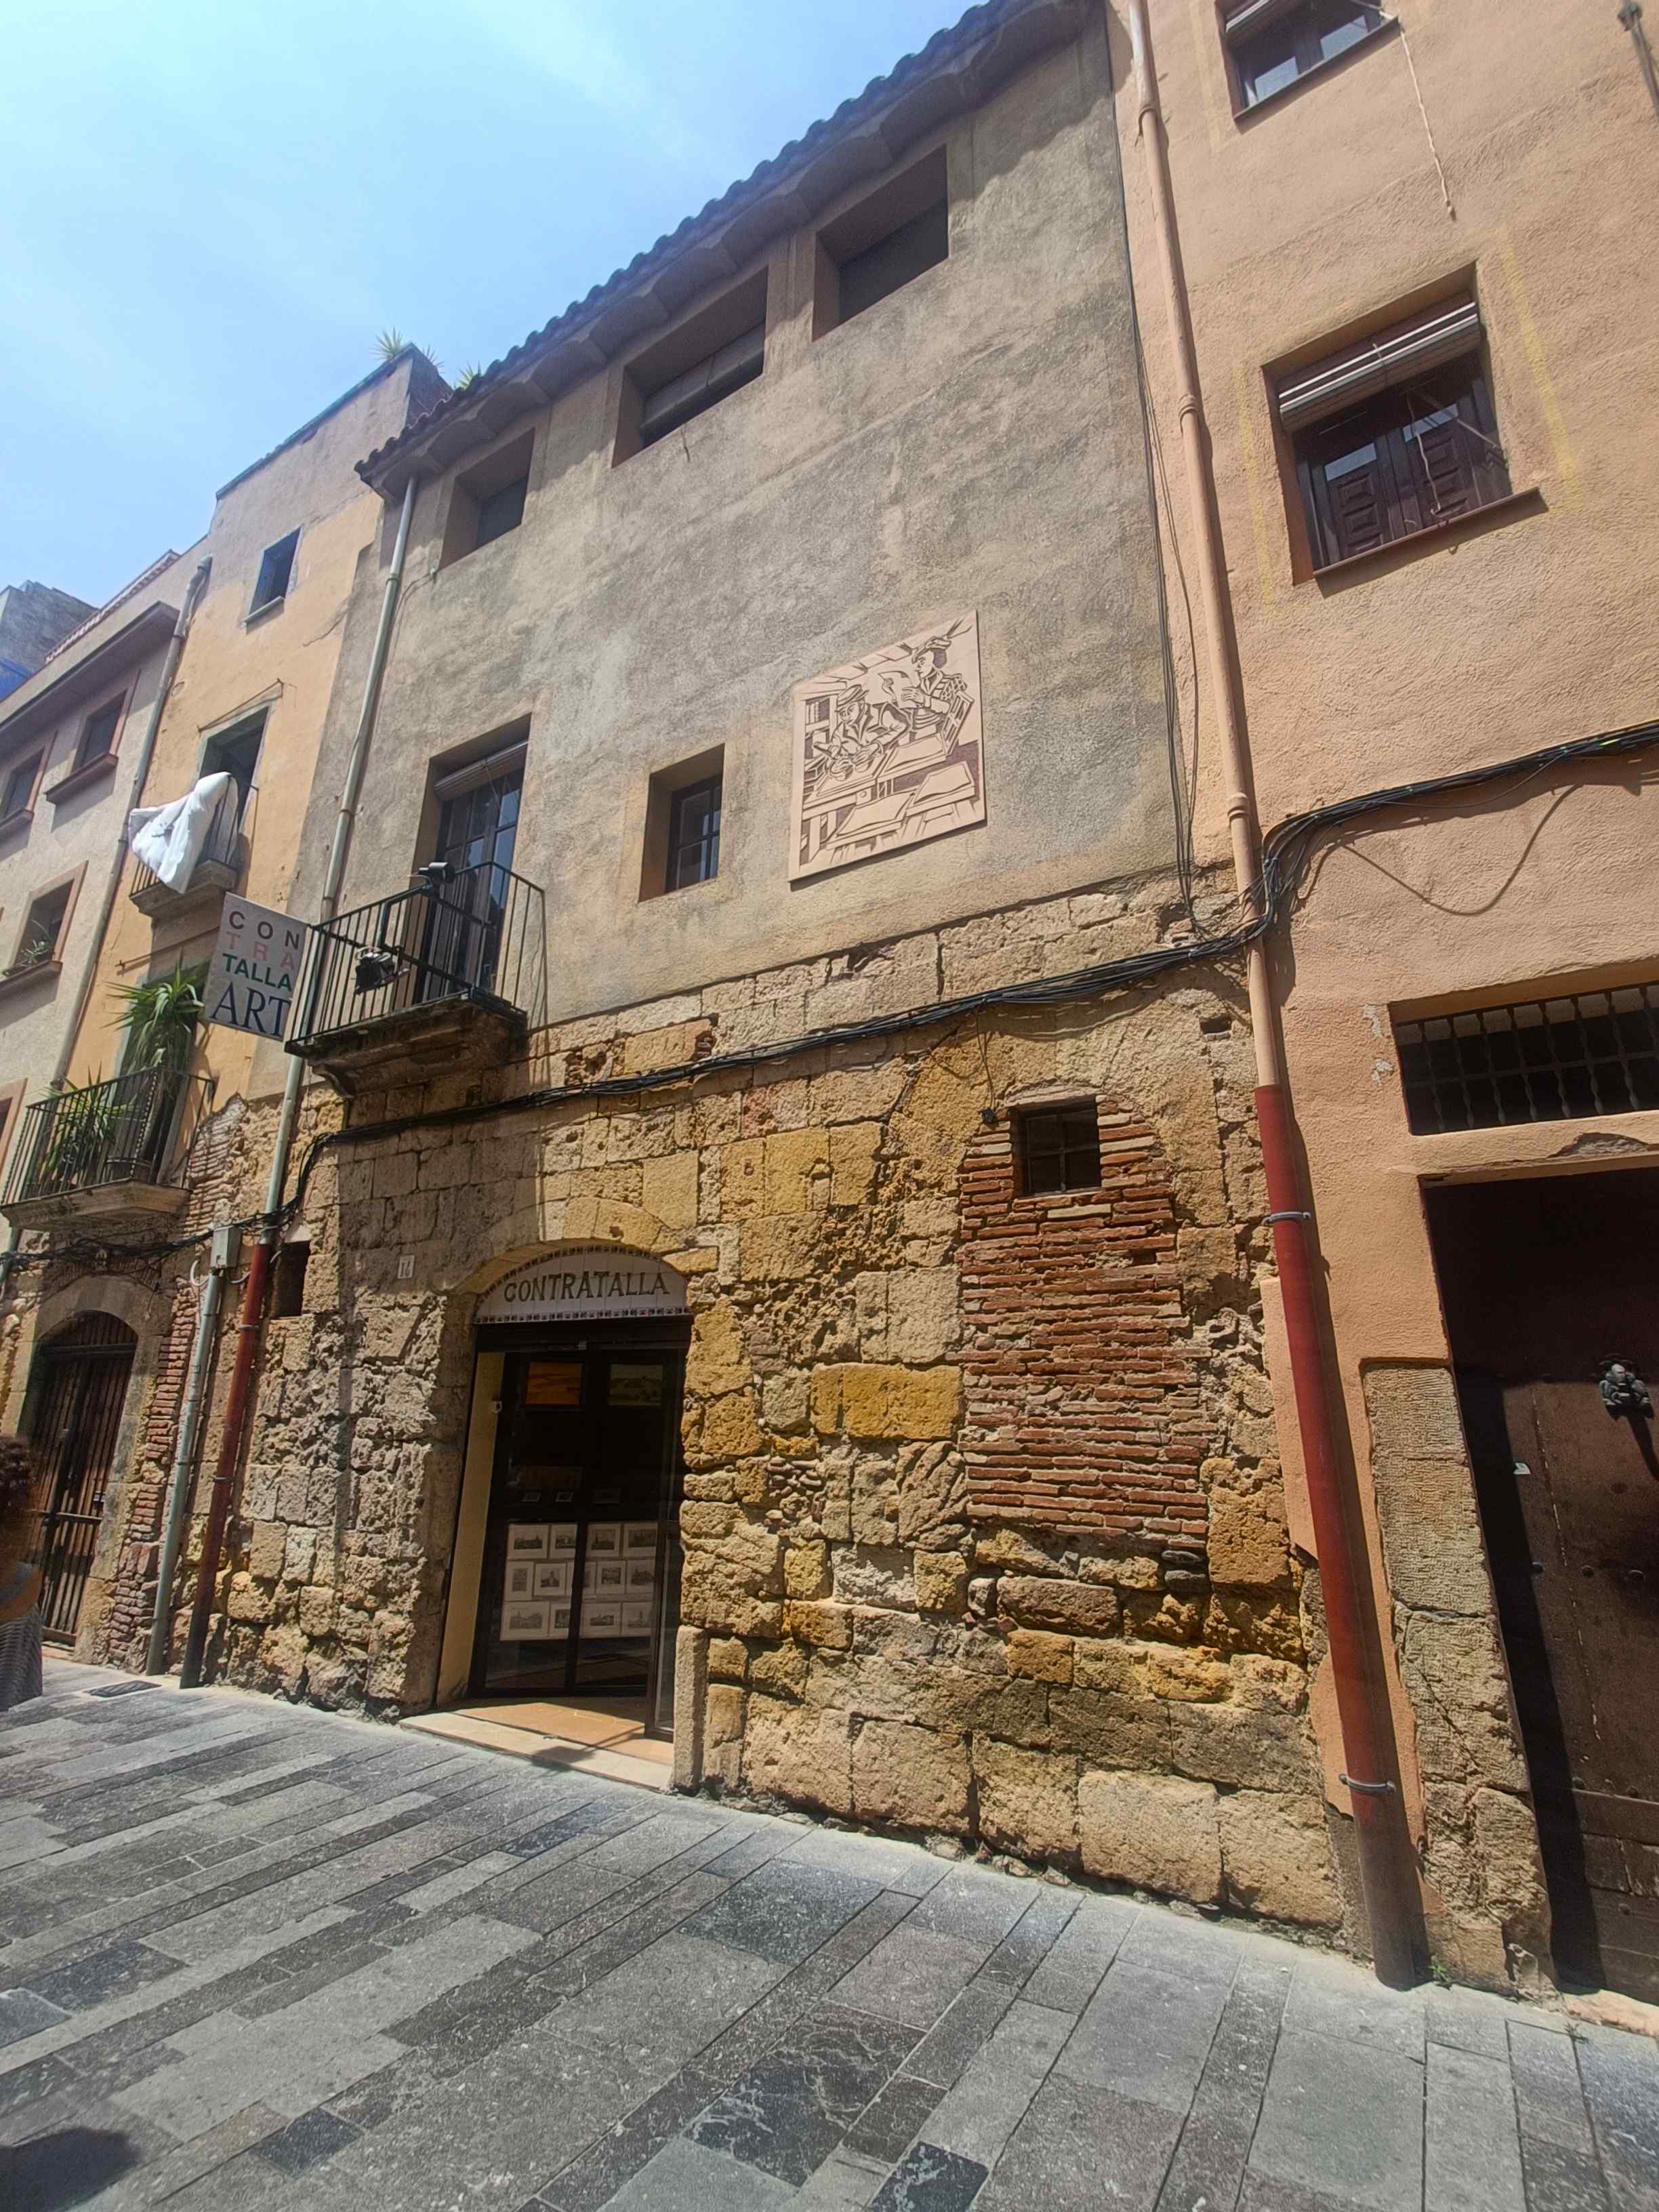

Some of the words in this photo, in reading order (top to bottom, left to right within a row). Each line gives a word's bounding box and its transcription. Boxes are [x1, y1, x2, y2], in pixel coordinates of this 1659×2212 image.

[229, 911, 300, 949] CON
[226, 931, 295, 970] TRA
[222, 953, 291, 992] TALLA
[209, 982, 292, 1038] ART
[504, 1271, 670, 1303] CONTRATALLA
